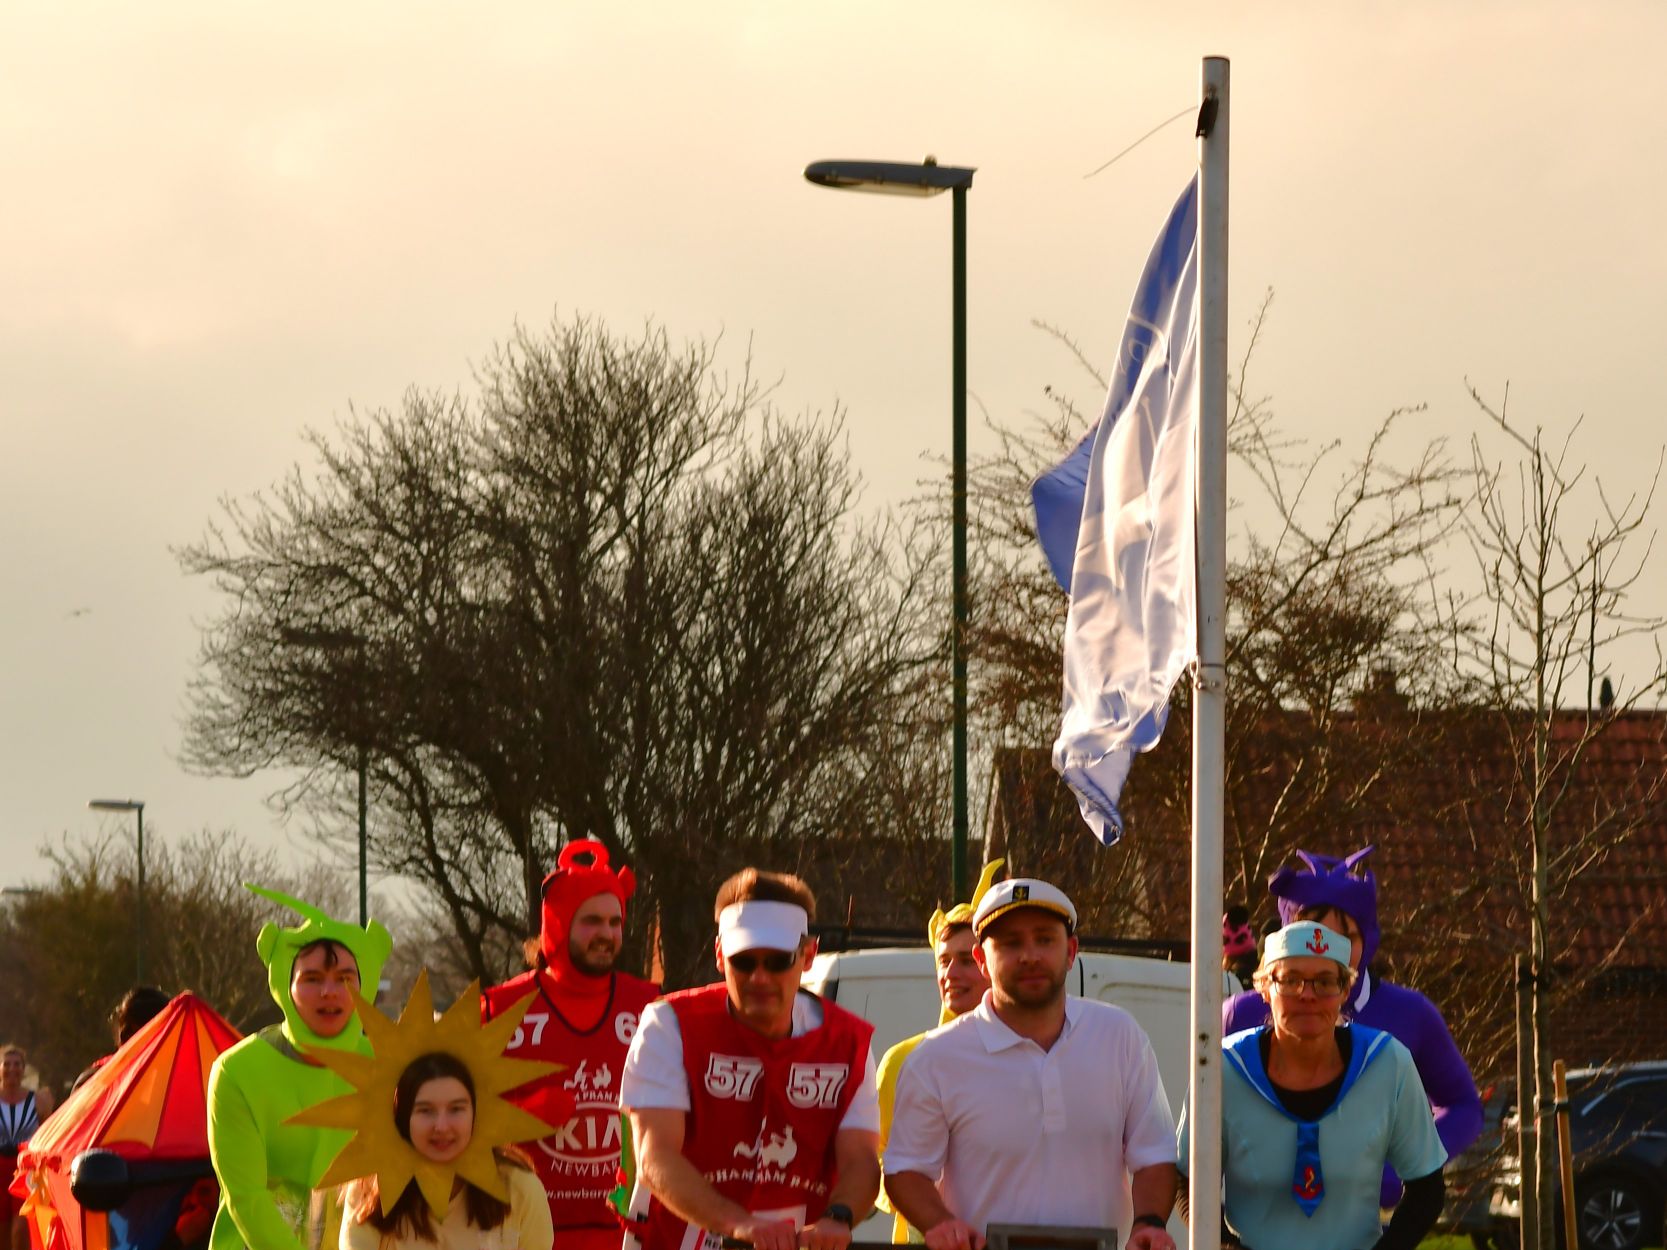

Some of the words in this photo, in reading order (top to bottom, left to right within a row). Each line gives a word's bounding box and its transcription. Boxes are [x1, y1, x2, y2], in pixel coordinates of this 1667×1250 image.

[615, 1011, 641, 1045] 6
[705, 1052, 764, 1102] 57
[786, 1062, 849, 1108] 57
[556, 1114, 621, 1150] KIA
